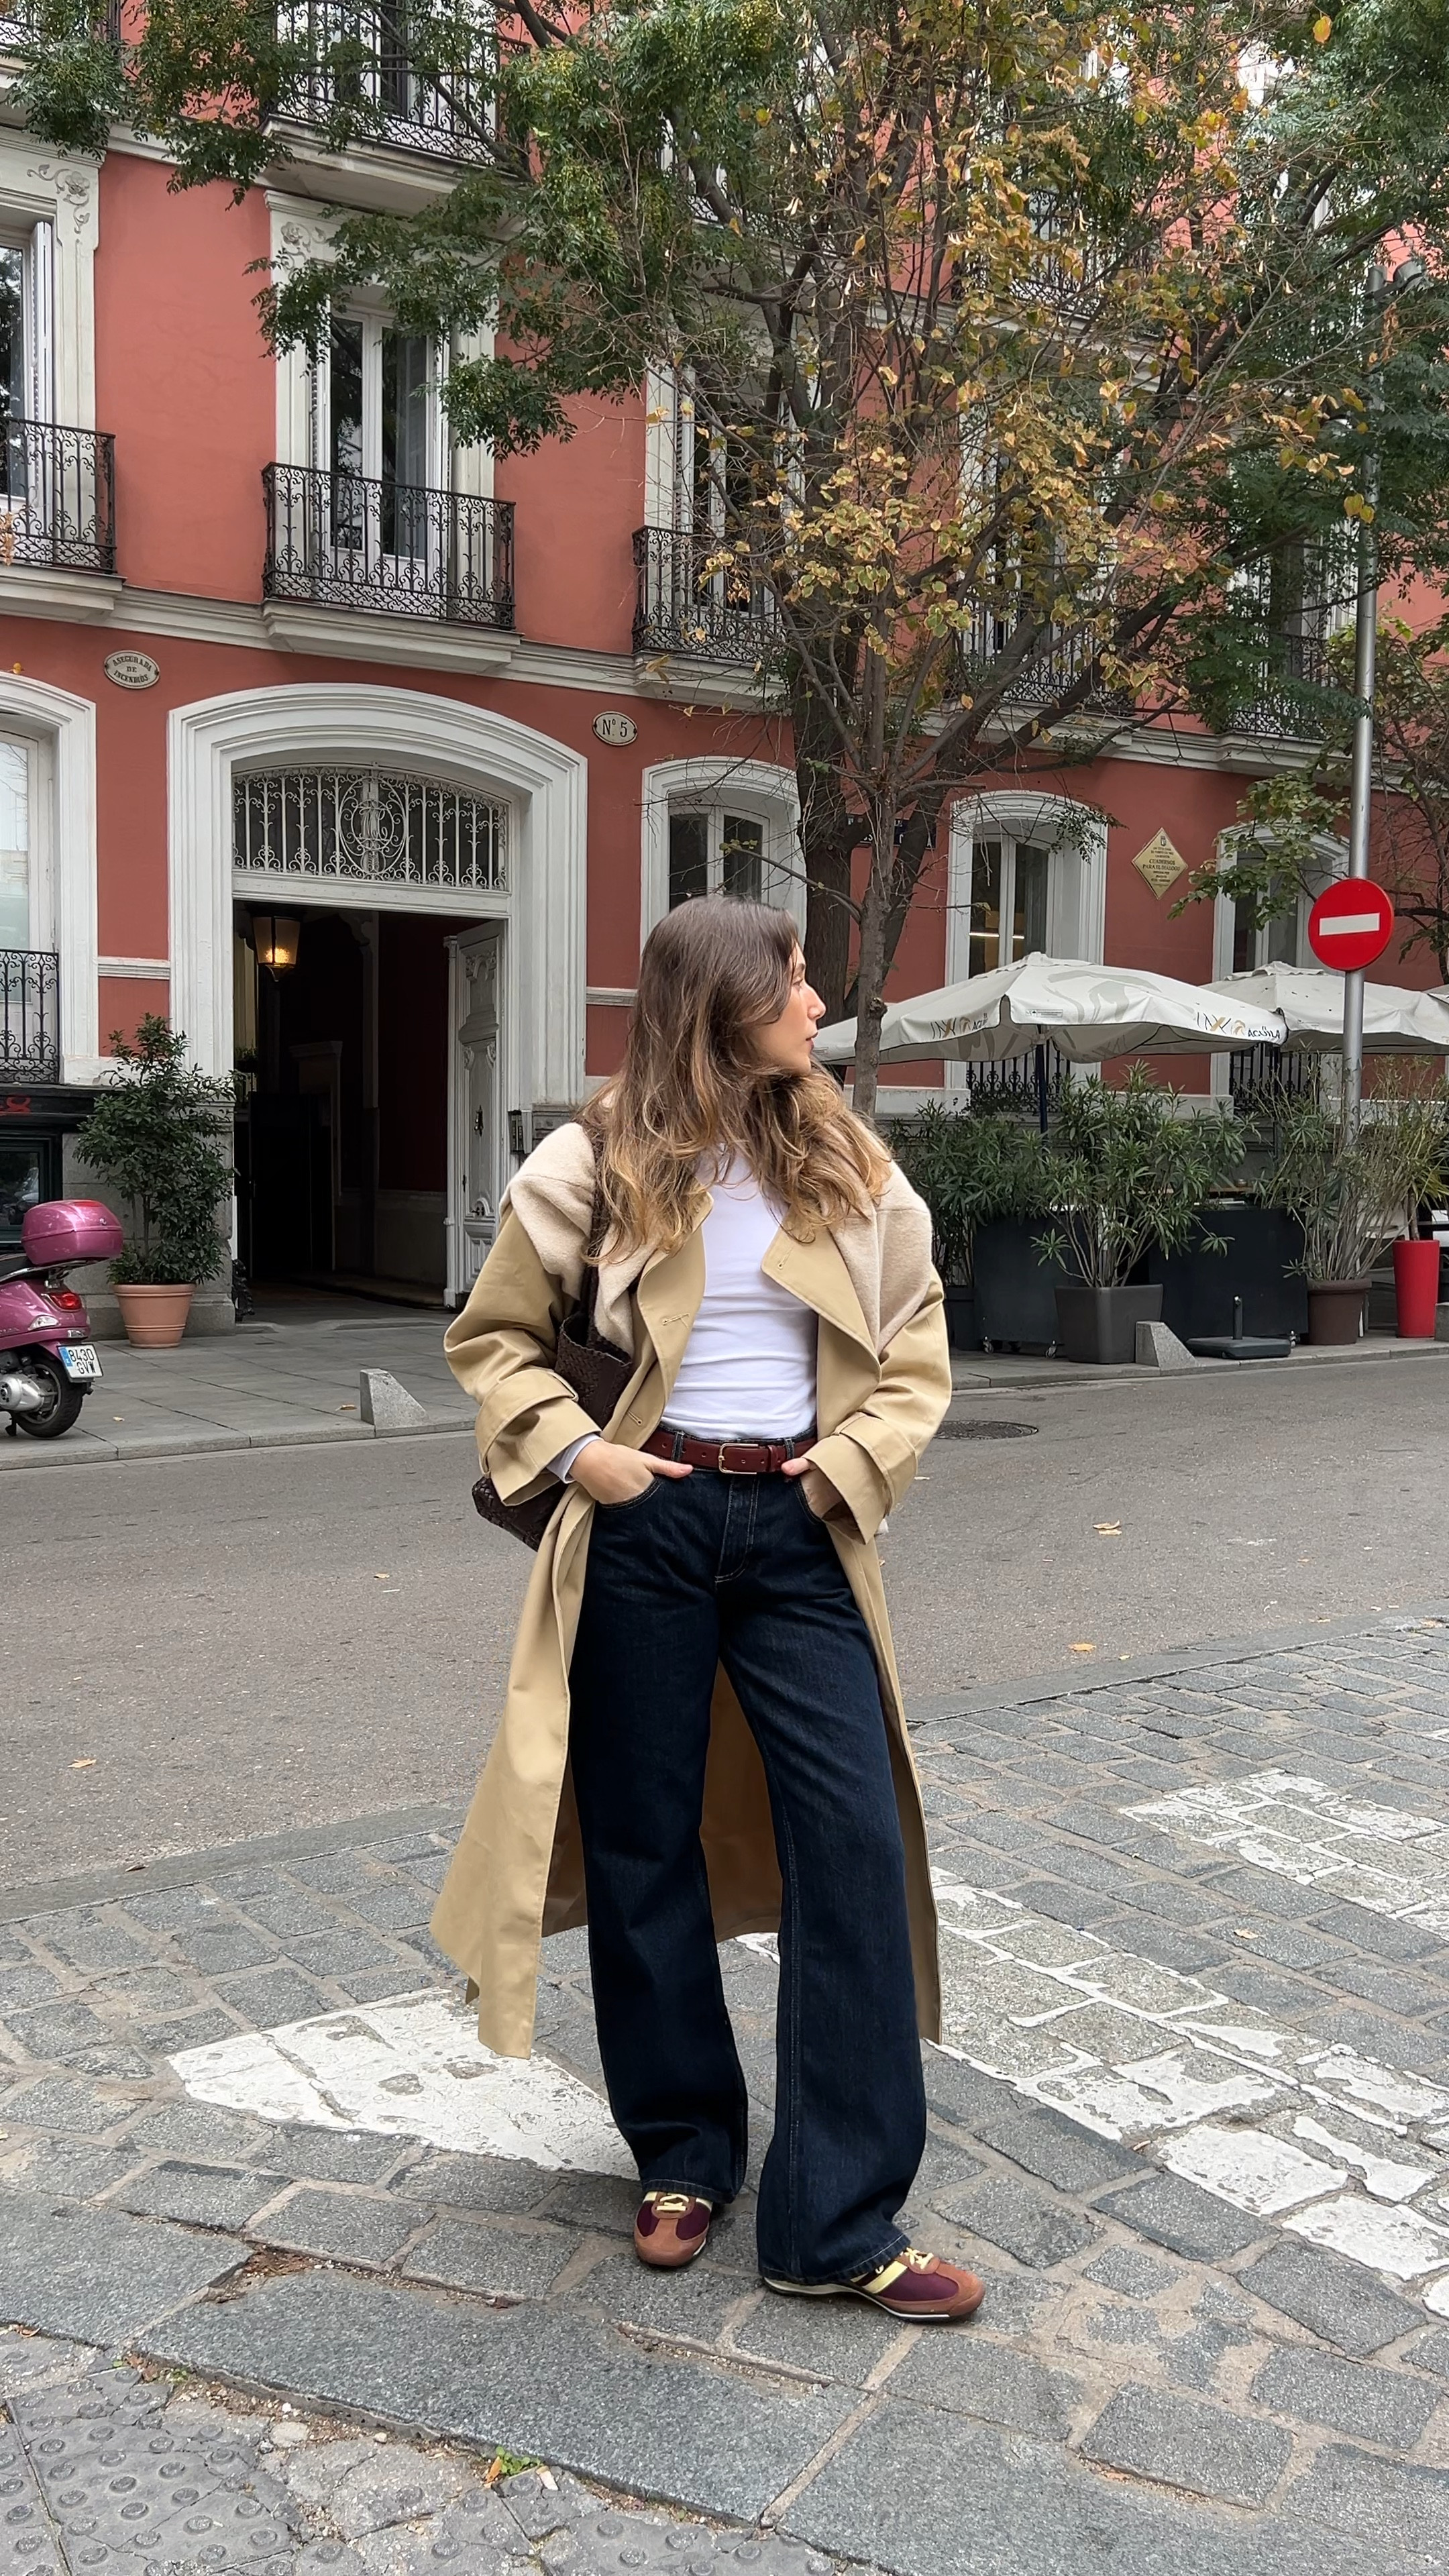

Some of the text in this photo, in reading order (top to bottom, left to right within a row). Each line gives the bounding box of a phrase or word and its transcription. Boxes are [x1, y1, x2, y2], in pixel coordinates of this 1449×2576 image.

[113, 655, 152, 672] ASEGURADA
[619, 721, 627, 738] 5
[68, 1348, 95, 1362] 8430
